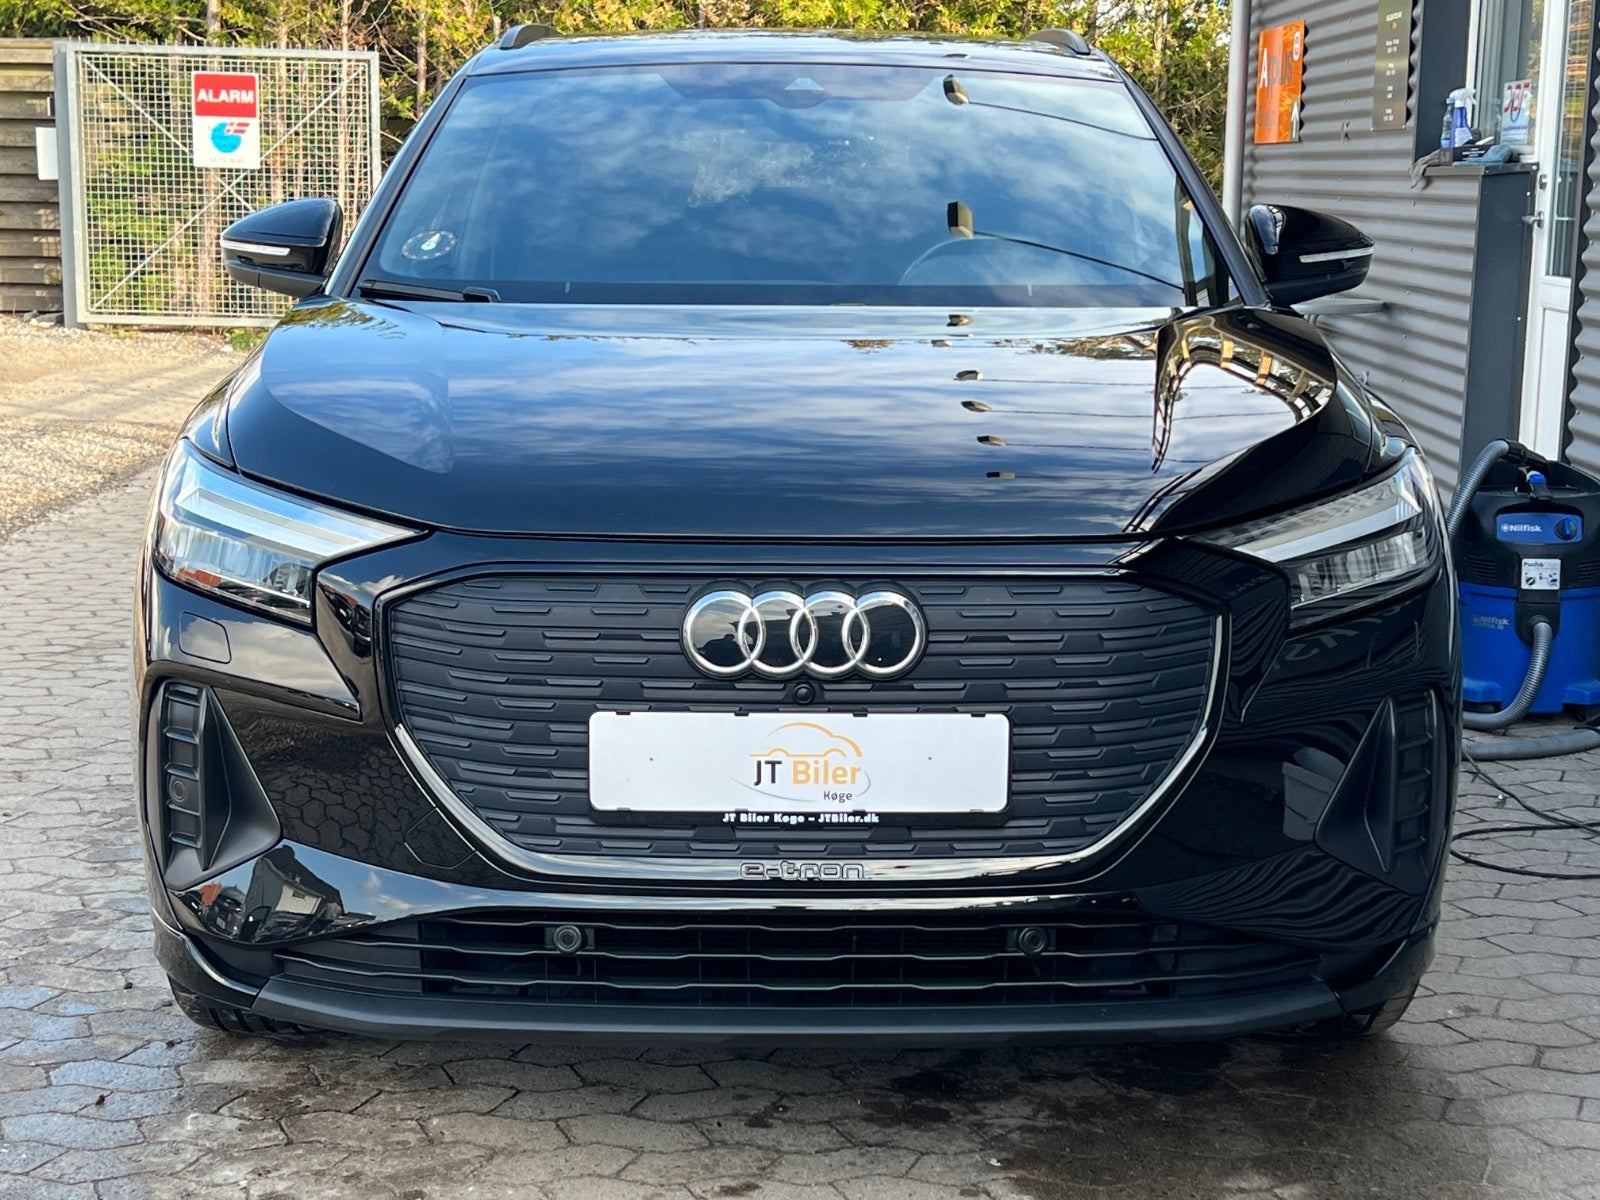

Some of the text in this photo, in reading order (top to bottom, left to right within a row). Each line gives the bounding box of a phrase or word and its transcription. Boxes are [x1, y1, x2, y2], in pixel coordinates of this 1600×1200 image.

[197, 89, 254, 104] ALARM
[1509, 524, 1542, 532] Nilfisk
[754, 760, 861, 786] JT Biler
[823, 790, 853, 803] Køge
[722, 813, 736, 823] JT
[740, 813, 770, 823] Biler
[818, 813, 880, 823] JTBiler.dk
[740, 860, 865, 881] e-tron
